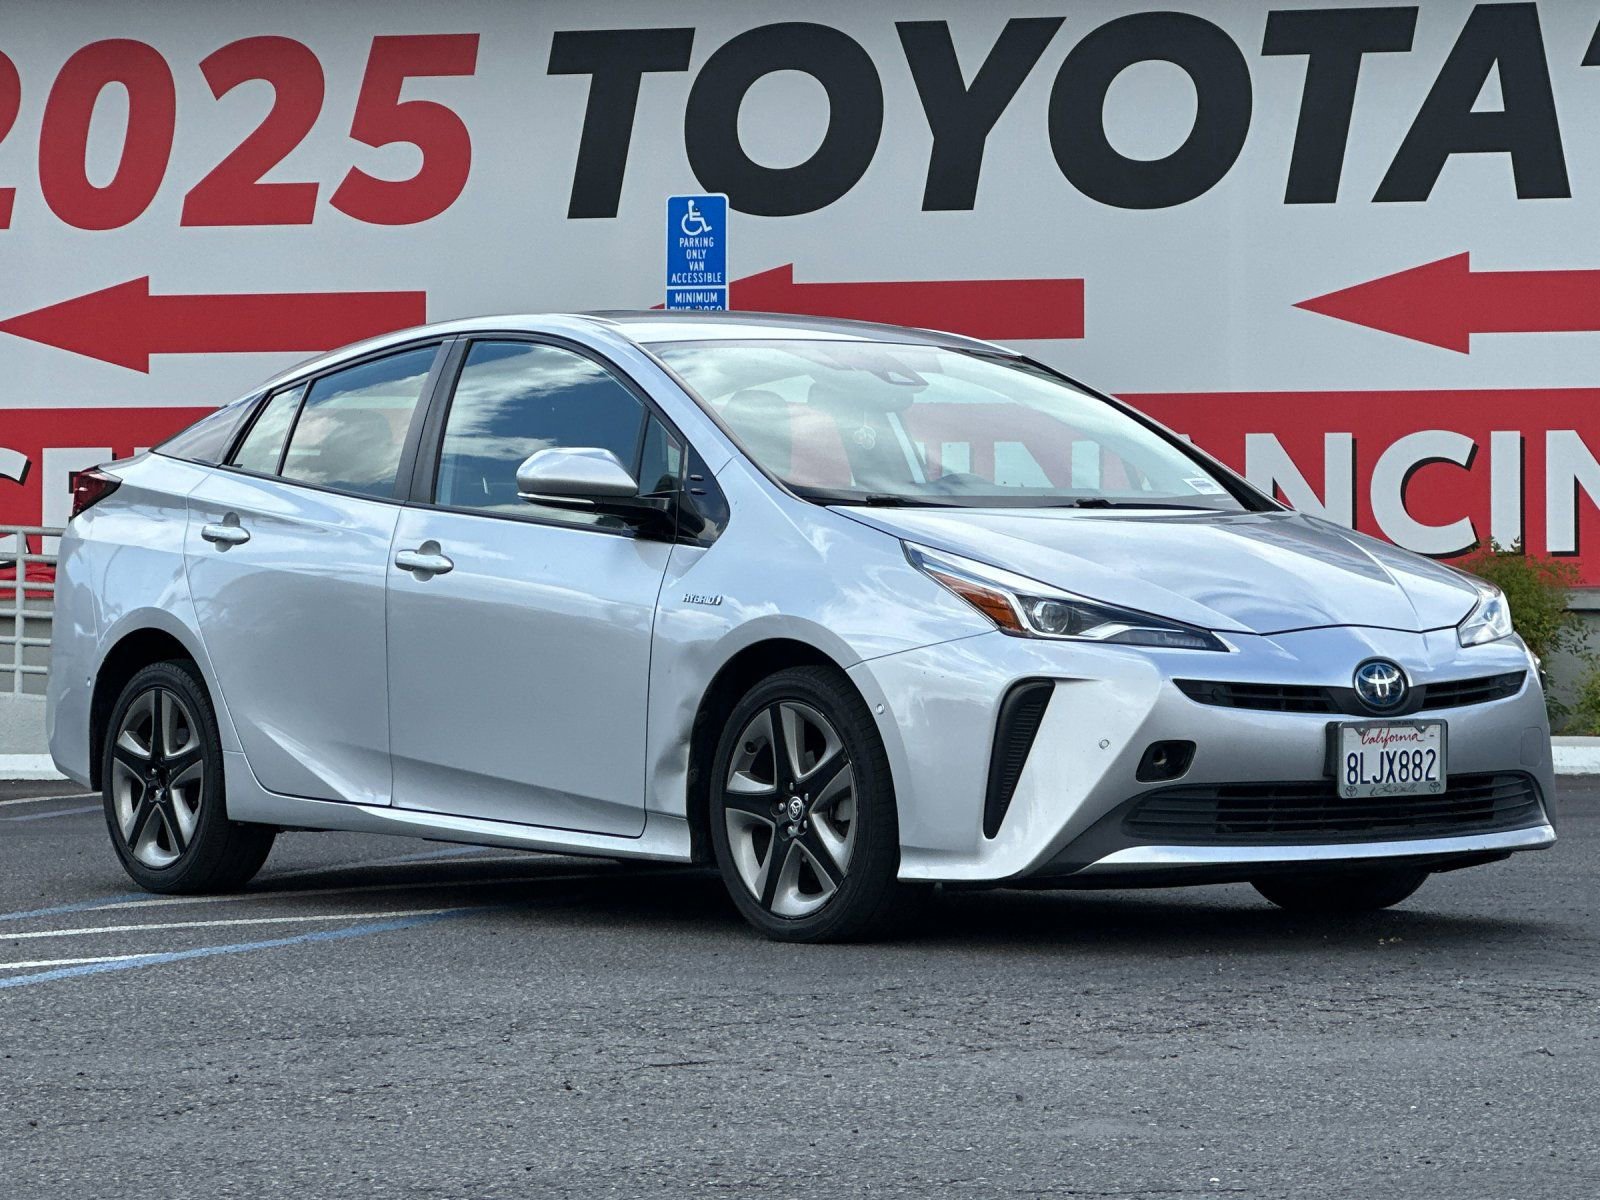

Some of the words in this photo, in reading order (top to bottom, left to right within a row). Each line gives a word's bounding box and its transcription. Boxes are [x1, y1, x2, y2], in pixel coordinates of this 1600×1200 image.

[0, 34, 480, 231] 025
[679, 237, 714, 248] PARKING
[686, 249, 707, 260] ONLY
[688, 261, 705, 272] VAN
[671, 272, 722, 284] ACCESSIBLE
[675, 292, 718, 303] MINIMUM
[1361, 727, 1424, 749] California
[1346, 748, 1437, 785] 8LJX882
